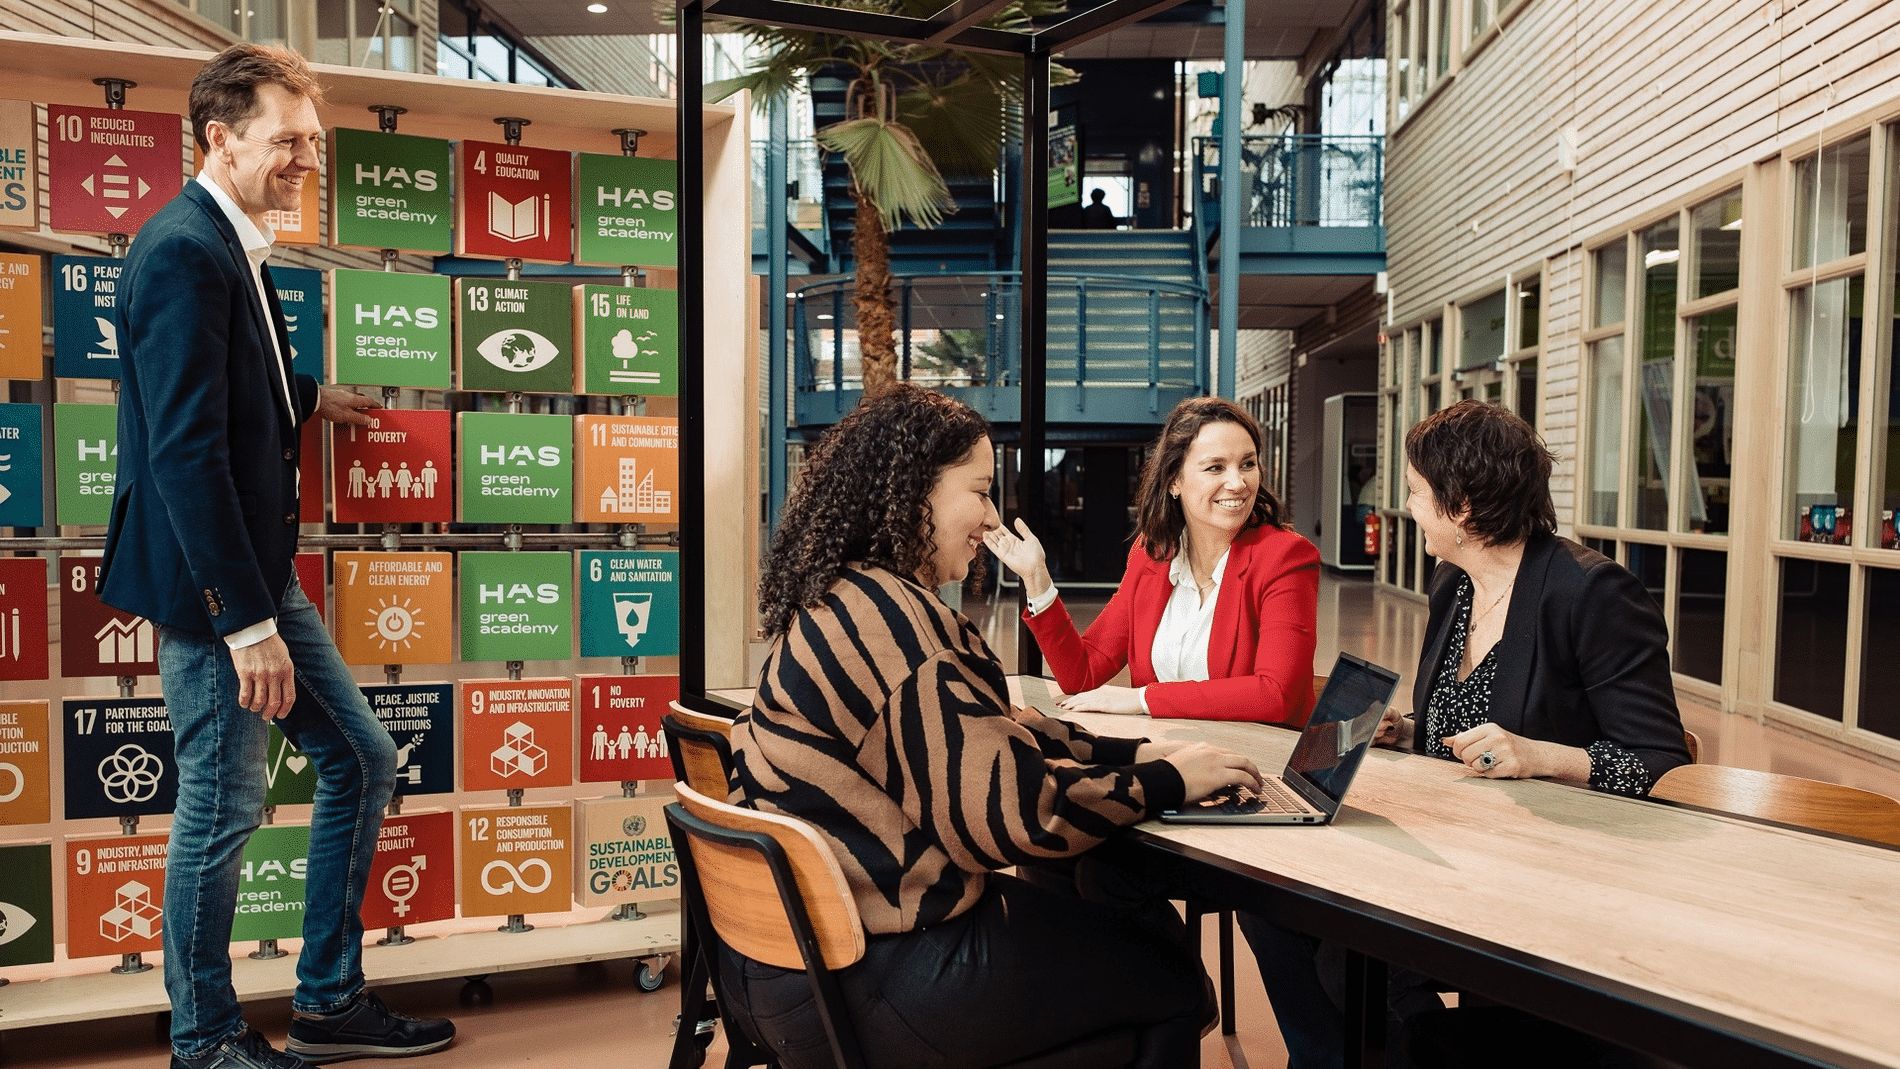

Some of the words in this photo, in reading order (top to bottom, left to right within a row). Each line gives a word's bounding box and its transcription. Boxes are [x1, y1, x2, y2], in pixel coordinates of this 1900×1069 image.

[56, 114, 83, 143] 10
[90, 116, 135, 132] REDUCED
[90, 131, 154, 148] INEQUALITIES
[474, 150, 487, 175] 4
[495, 152, 529, 166] QUALITY
[355, 163, 438, 192] HAS
[495, 166, 540, 181] EDUCATION
[356, 195, 407, 208] green
[597, 186, 675, 211] HAS
[356, 207, 437, 225] academy
[598, 216, 646, 228] green
[598, 227, 674, 243] academy
[8, 263, 30, 276] AND
[94, 265, 122, 279] PEAC
[61, 264, 87, 292] 16
[94, 281, 115, 293] AND
[495, 287, 529, 300] CLIMATE
[467, 286, 489, 312] 13
[591, 293, 610, 318] 15
[616, 294, 631, 306] LIFE
[495, 301, 525, 313] ACTION
[616, 308, 627, 318] ON
[630, 308, 650, 320] LAND
[355, 303, 438, 329] HAS
[355, 335, 407, 347] green
[356, 346, 438, 362] academy
[368, 431, 407, 443] POVERTY
[591, 423, 607, 447] 11
[611, 424, 660, 436] SUSTAINABLE
[611, 436, 628, 447] AND
[628, 437, 678, 449] COMMUNITIES
[78, 439, 118, 462] H
[480, 444, 561, 467] HAS
[481, 474, 531, 486] green
[481, 485, 560, 499] academy
[368, 561, 423, 573] AFFORDABLE
[424, 561, 443, 572] AND
[590, 558, 602, 582] 6
[610, 558, 636, 570] CLEAN
[636, 559, 662, 570] WATER
[71, 565, 87, 593] 8
[347, 561, 359, 586] 7
[368, 574, 397, 586] CLEAN
[398, 574, 431, 586] ENERGY
[610, 571, 627, 582] AND
[628, 571, 673, 582] SANITATION
[479, 583, 560, 604] HAS
[480, 612, 529, 624] green
[480, 624, 559, 635] academy
[489, 690, 527, 702] INDUSTRY,
[528, 688, 571, 700] INNOVATION
[592, 685, 600, 709] 1
[610, 685, 622, 696] NO
[374, 694, 405, 706] PEACE,
[405, 692, 440, 705] JUSTICE
[471, 690, 485, 715] 9
[610, 697, 645, 709] POVERTY
[375, 708, 393, 719] AND
[395, 706, 428, 718] STRONG
[489, 703, 506, 714] AND
[506, 701, 570, 713] INFRASTRUCTURE
[74, 708, 97, 735] 17
[105, 722, 124, 734] FOR
[126, 721, 144, 733] THE
[496, 815, 548, 828] RESPONSIBLE
[468, 817, 489, 841] 12
[496, 827, 552, 840] CONSUMPTION
[377, 837, 415, 852] EQUALITY
[496, 841, 513, 853] AND
[514, 839, 564, 852] PRODUCTION
[590, 837, 674, 856] SUSTAINABL
[97, 846, 142, 860] INDUSTRY,
[76, 849, 91, 875] 9
[97, 862, 117, 874] AND
[237, 889, 281, 902] reen
